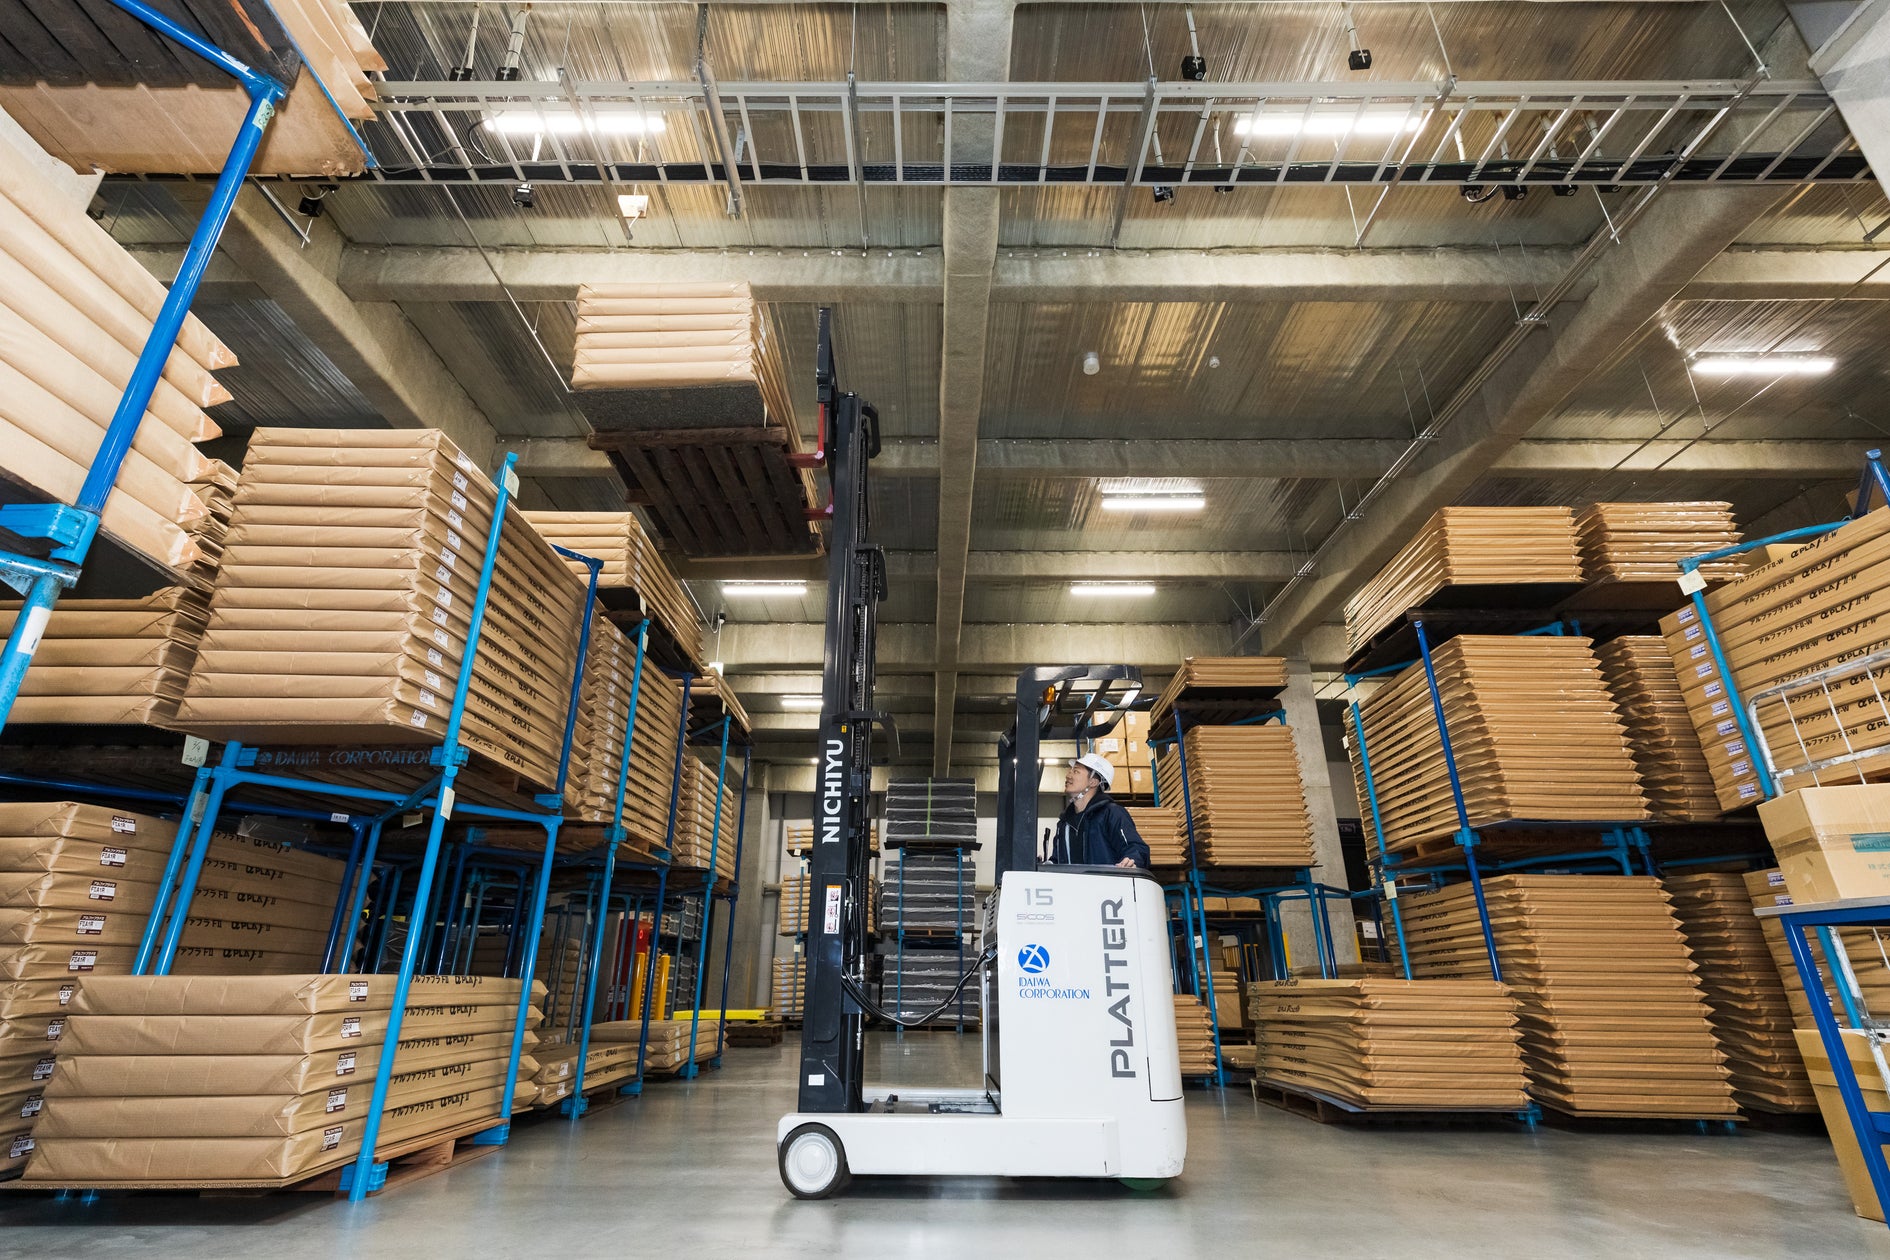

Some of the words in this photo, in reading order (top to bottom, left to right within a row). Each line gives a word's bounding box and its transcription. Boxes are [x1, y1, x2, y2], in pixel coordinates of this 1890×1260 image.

[822, 740, 844, 844] NICHIYU
[1025, 888, 1054, 906] 15
[1018, 977, 1051, 987] DAIWA
[1100, 897, 1136, 1078] PLATTER
[1019, 988, 1090, 999] CORPORATION
